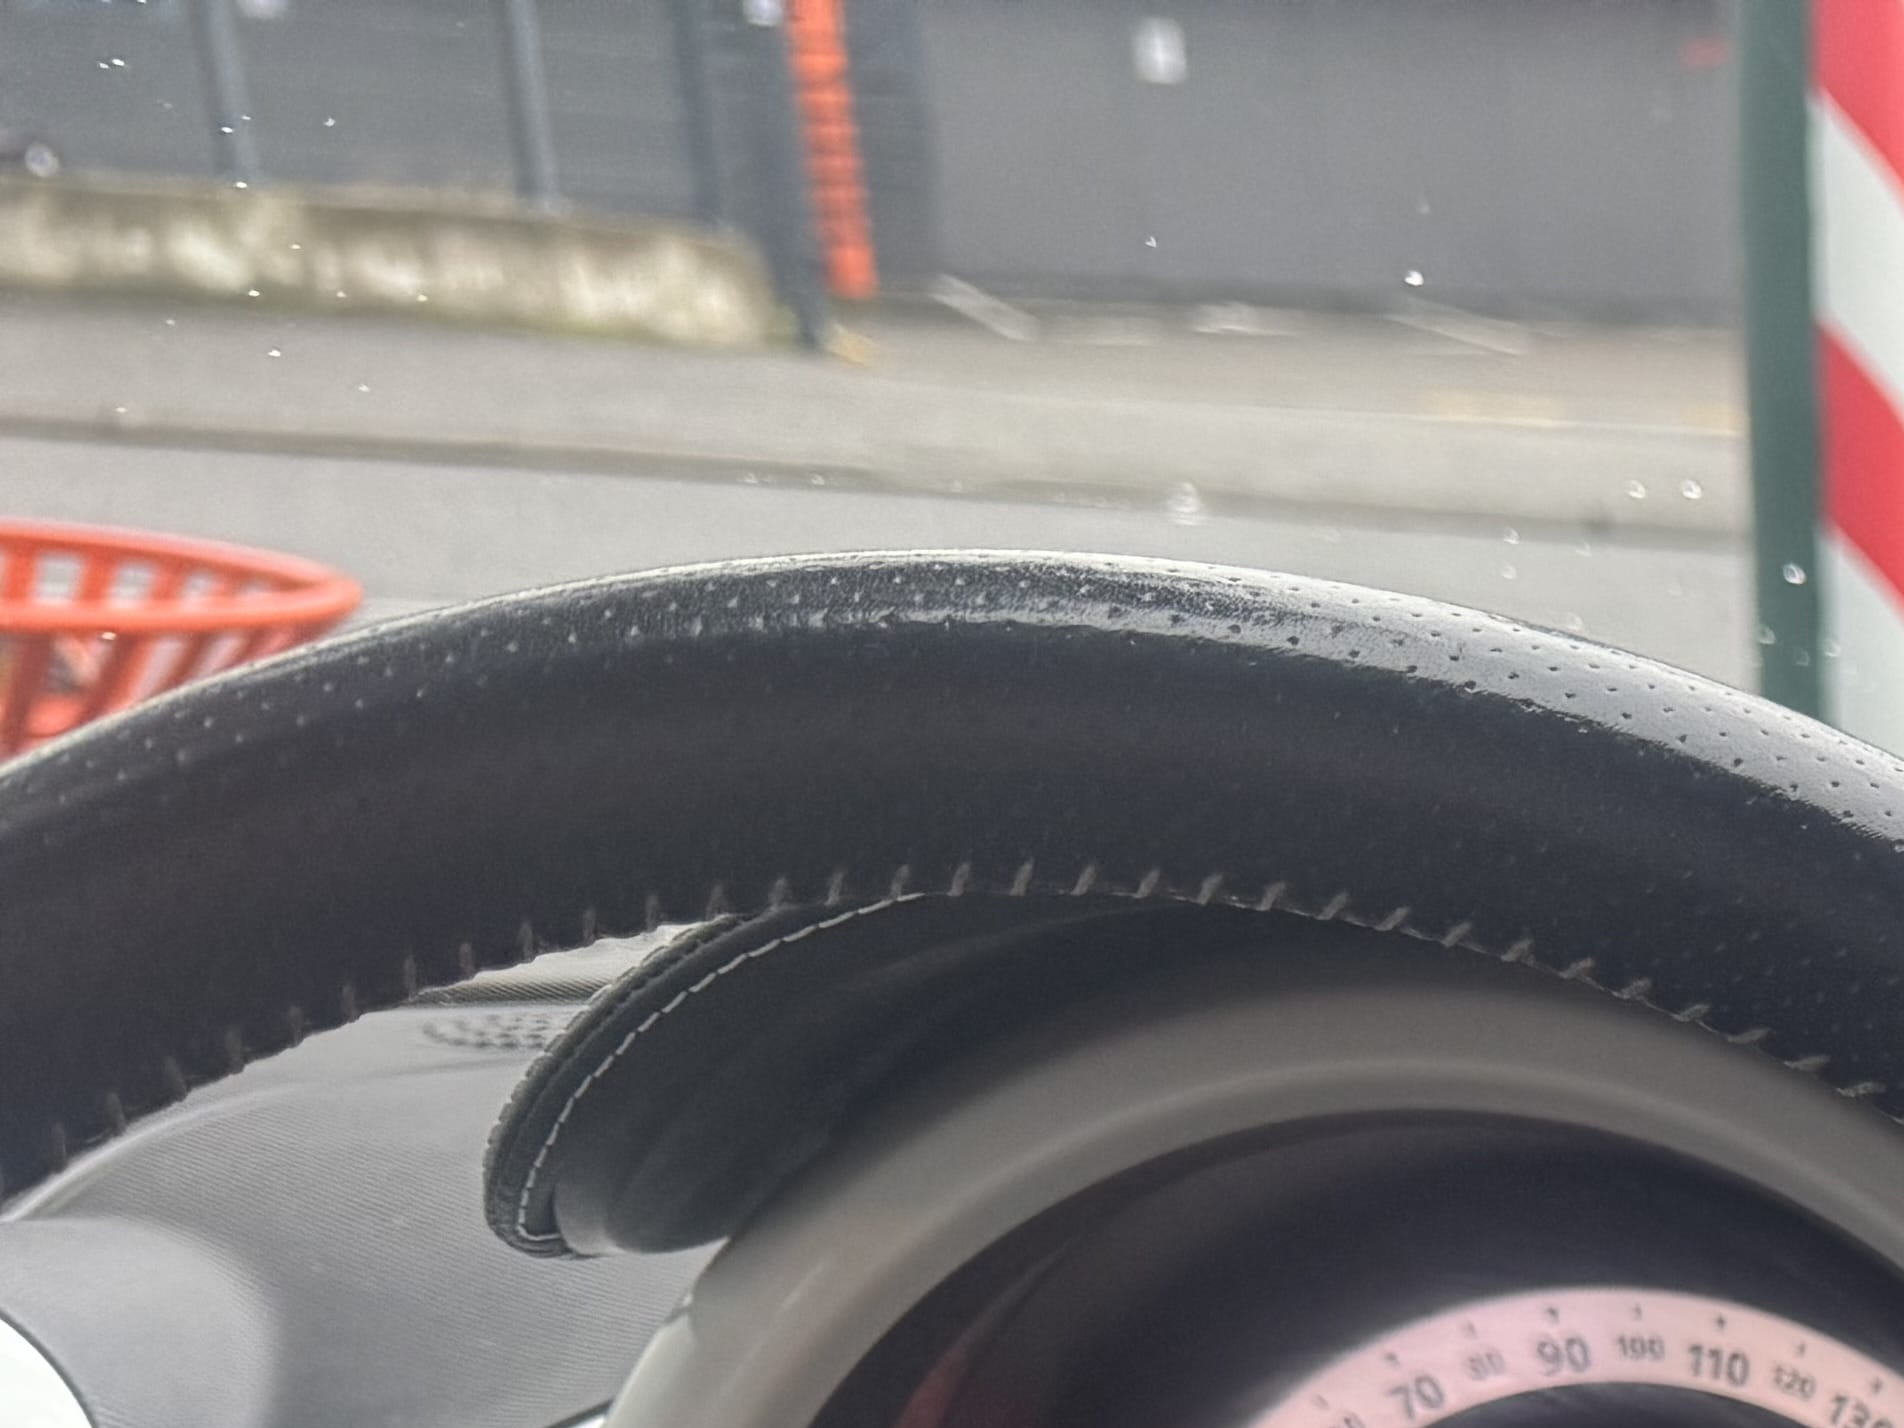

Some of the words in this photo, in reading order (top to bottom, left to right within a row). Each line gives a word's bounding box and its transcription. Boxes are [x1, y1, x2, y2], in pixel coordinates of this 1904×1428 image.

[1537, 1336, 1592, 1376] 90
[1616, 1335, 1666, 1360] 100
[1688, 1343, 1751, 1386] 110
[1383, 1374, 1444, 1419] 70
[1773, 1363, 1817, 1399] 120
